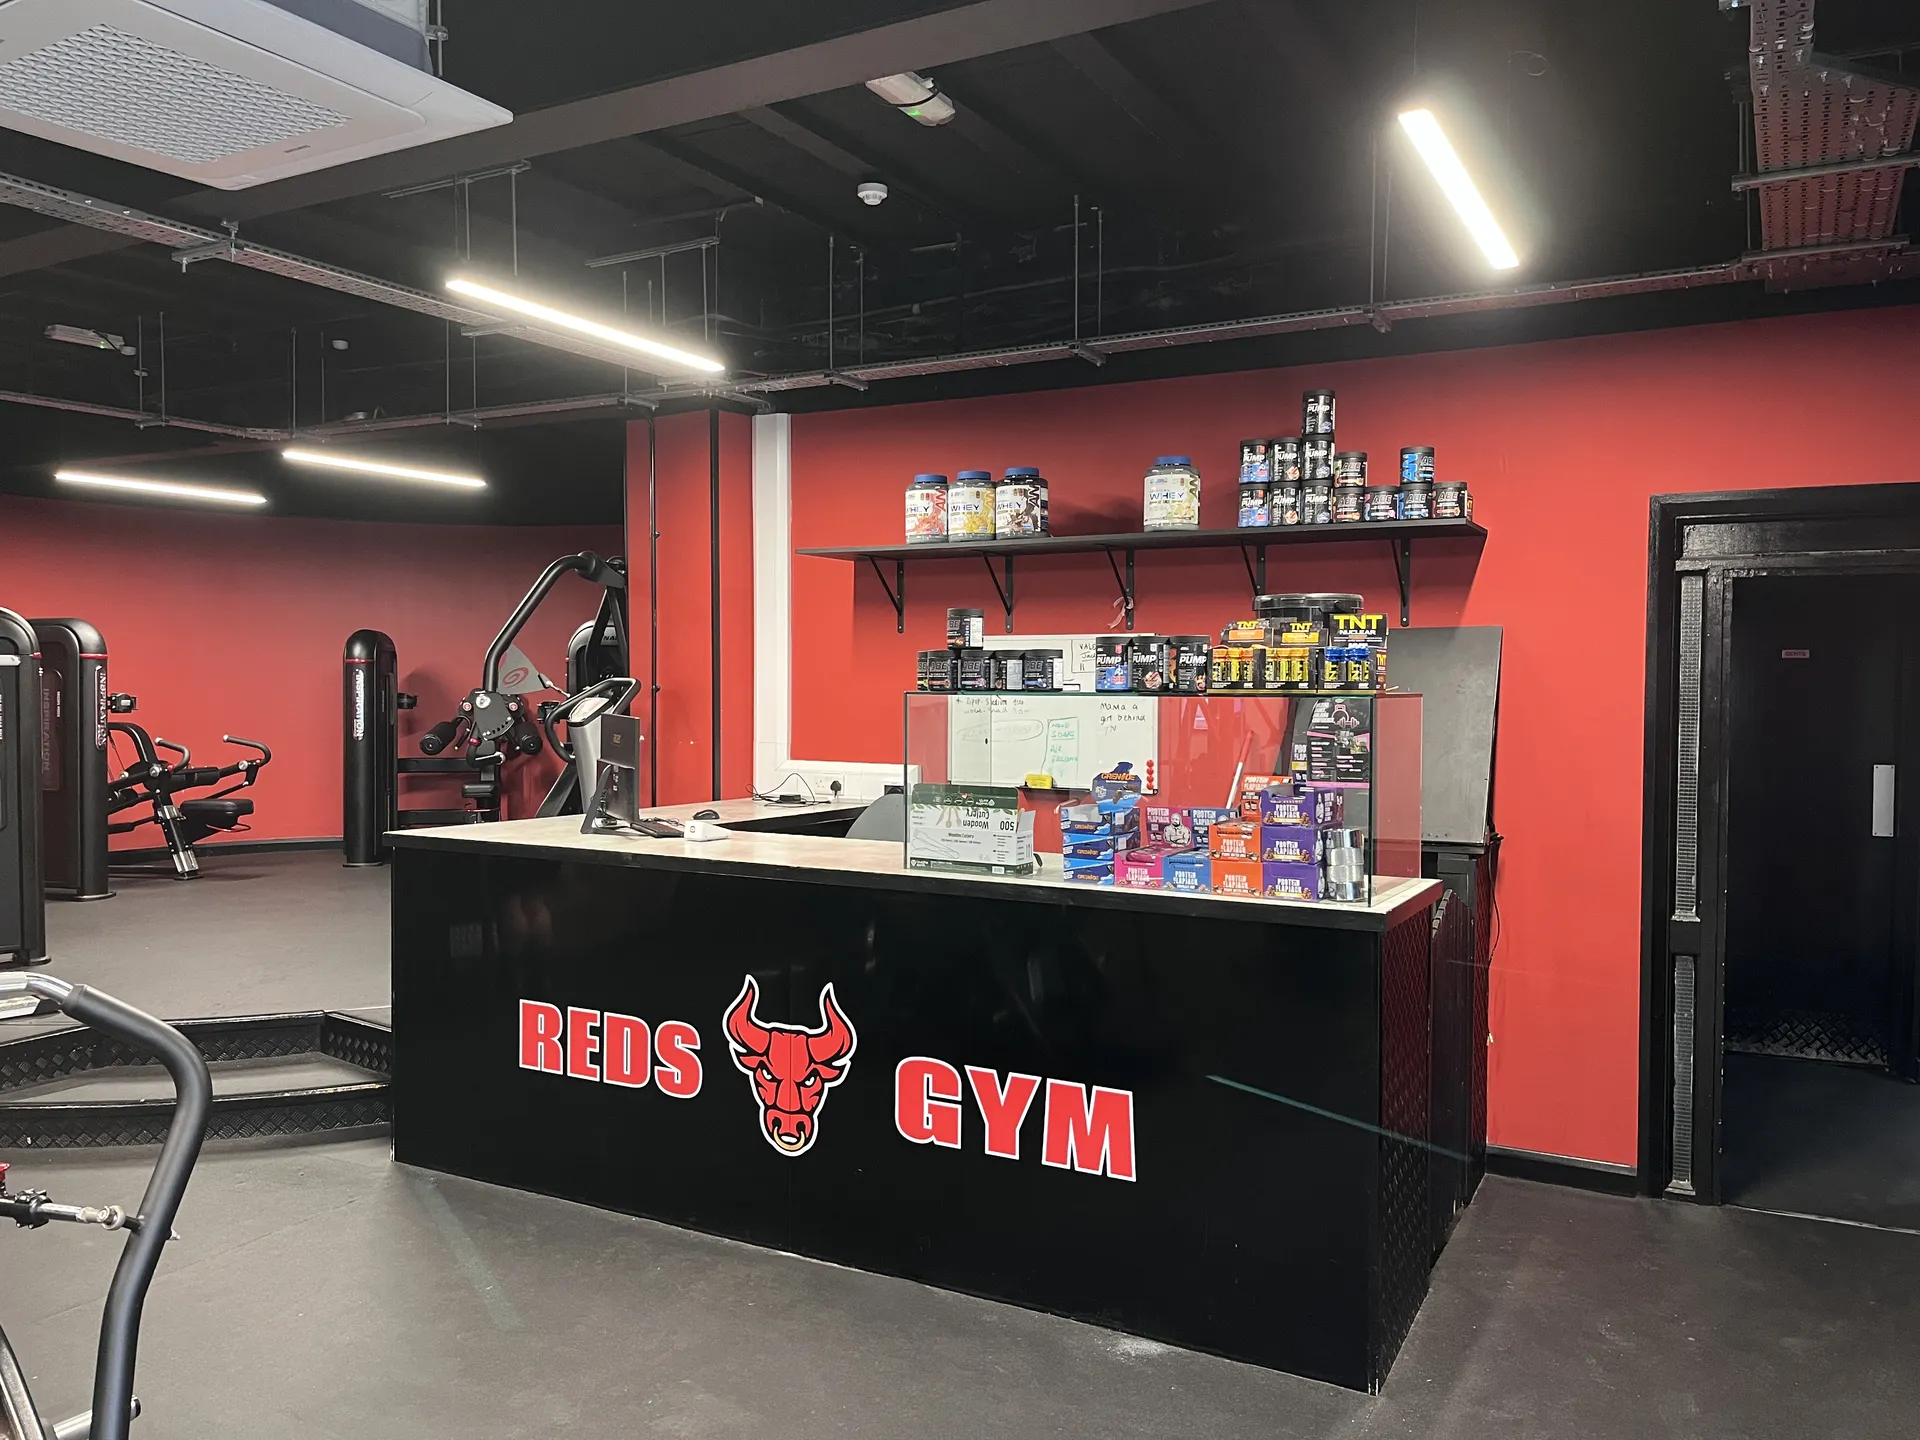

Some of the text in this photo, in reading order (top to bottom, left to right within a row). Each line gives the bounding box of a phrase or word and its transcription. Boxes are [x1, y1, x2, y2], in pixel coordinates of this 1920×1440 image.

[1149, 492, 1185, 501] WHEY
[951, 504, 980, 512] WHEY
[1290, 622, 1312, 630] TNT
[1334, 614, 1383, 630] TNT
[1096, 656, 1122, 665] PUMP
[1133, 655, 1157, 663] PUMP
[1179, 655, 1207, 664] PUMP
[1101, 772, 1136, 780] GRENADE
[966, 808, 990, 819] Cutlery
[962, 820, 989, 830] Wooden
[999, 820, 1015, 831] 500
[519, 998, 1138, 1183] REDS GYM
